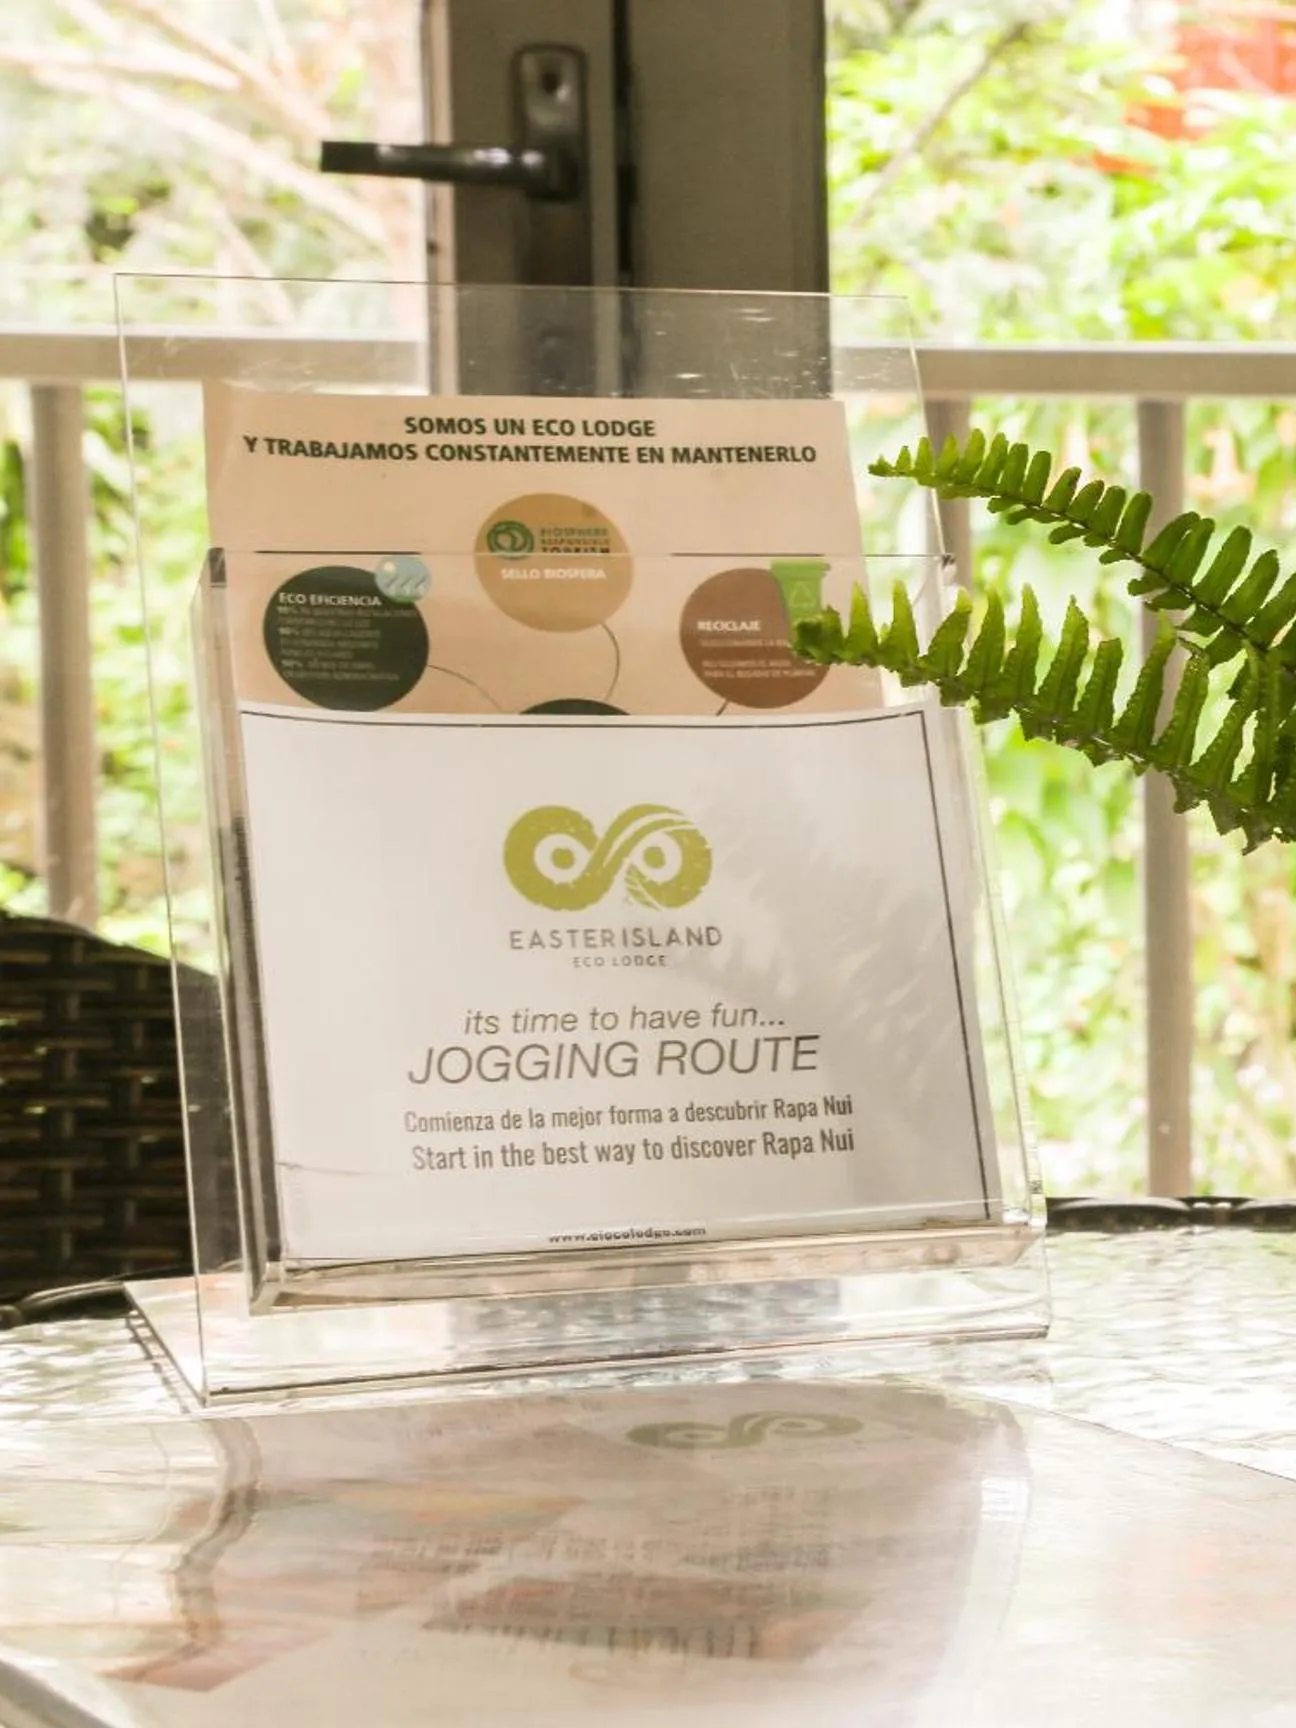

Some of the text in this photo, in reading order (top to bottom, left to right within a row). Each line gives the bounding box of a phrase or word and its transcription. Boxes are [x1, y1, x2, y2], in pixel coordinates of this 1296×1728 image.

[404, 417, 656, 437] SOMOS UN ECO LODGE
[242, 435, 817, 463] Y TRABAJAMOS CONSTANTEMENTE EN MANTENERLO
[501, 568, 607, 580] SELLO BIOSFERA
[279, 592, 382, 606] ECO EFICIENCIA
[696, 620, 761, 632] RECICLAJE
[573, 954, 667, 968] ECO LODGE
[464, 1002, 785, 1035] its time to have fun...
[407, 1034, 821, 1084] JOGGING ROUTE
[403, 1094, 854, 1133] Comienza de la mejor forma a descubrir Rapa Nui
[412, 1128, 854, 1171] Start in the best way to discover Rapa Nui
